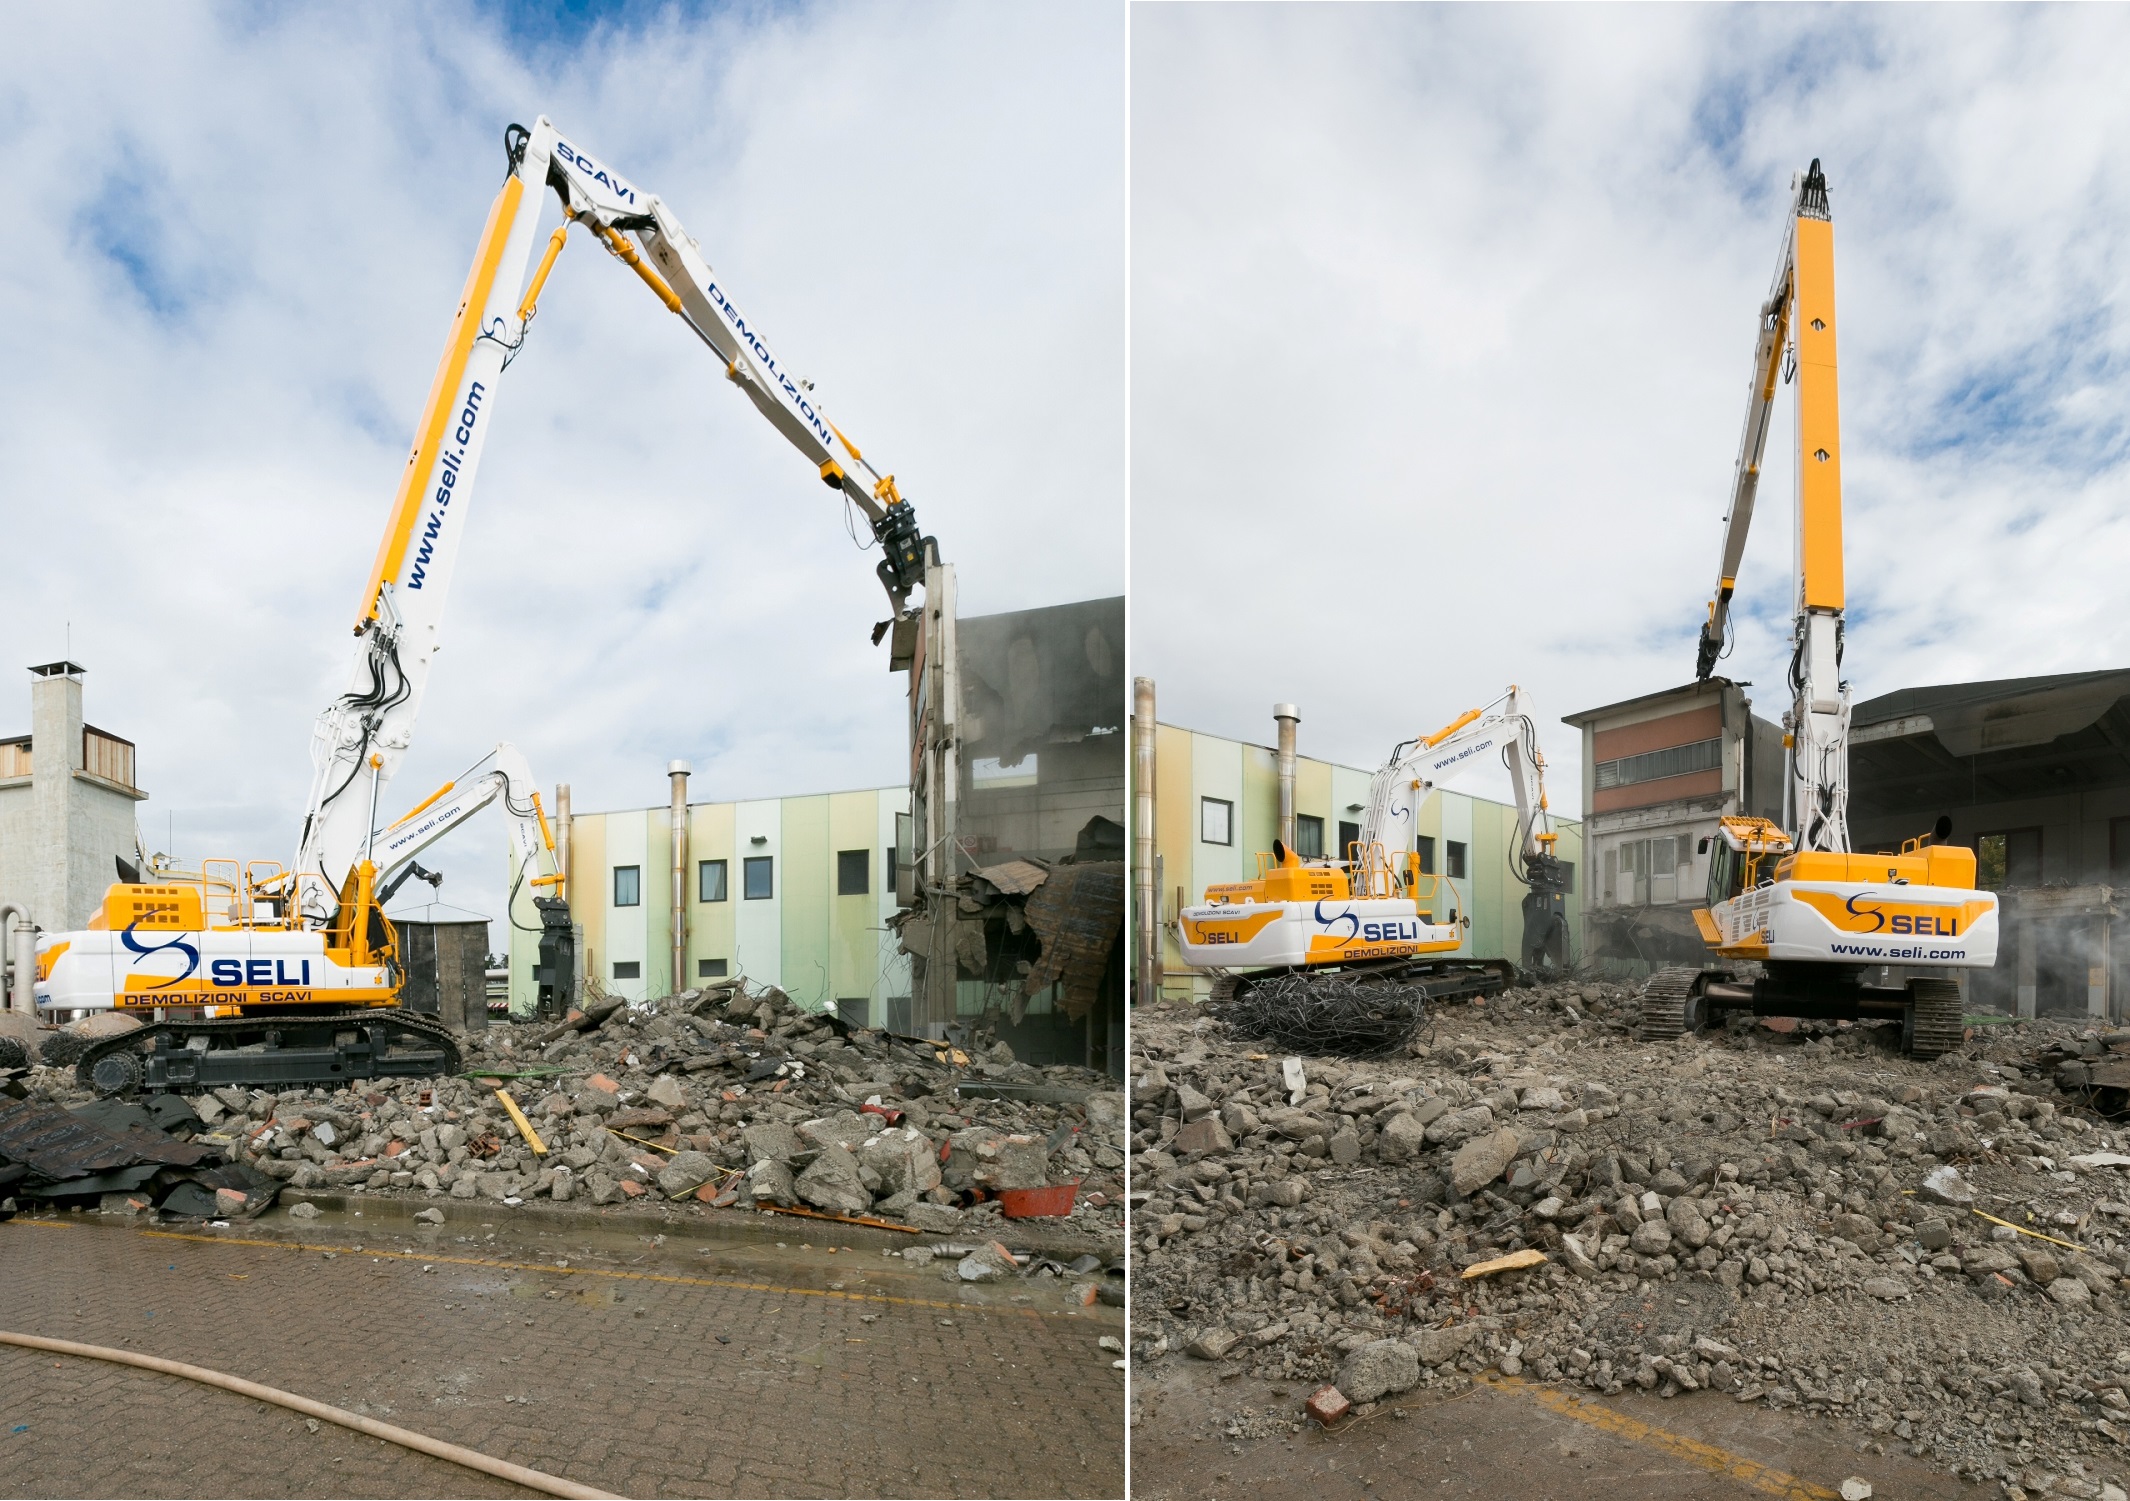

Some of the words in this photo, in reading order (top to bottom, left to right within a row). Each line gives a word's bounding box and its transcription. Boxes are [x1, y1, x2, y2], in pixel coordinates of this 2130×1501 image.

[557, 142, 635, 205] SCAVI
[708, 283, 831, 445] DEMOLIZIONI
[408, 381, 485, 590] www.seli.com
[1434, 740, 1493, 770] www.seli.com
[389, 805, 461, 850] www.seli.com
[1364, 922, 1417, 942] SELI
[1761, 930, 1775, 944] SELI
[1891, 915, 1957, 937] SELI
[1208, 932, 1238, 944] SELI
[1344, 945, 1418, 958] DEMOLIZIONI
[1831, 944, 1966, 959] www.seli.com
[211, 959, 310, 987] SELI
[124, 993, 247, 1006] DEMOLIZIONI
[259, 991, 312, 1002] SCAVI
